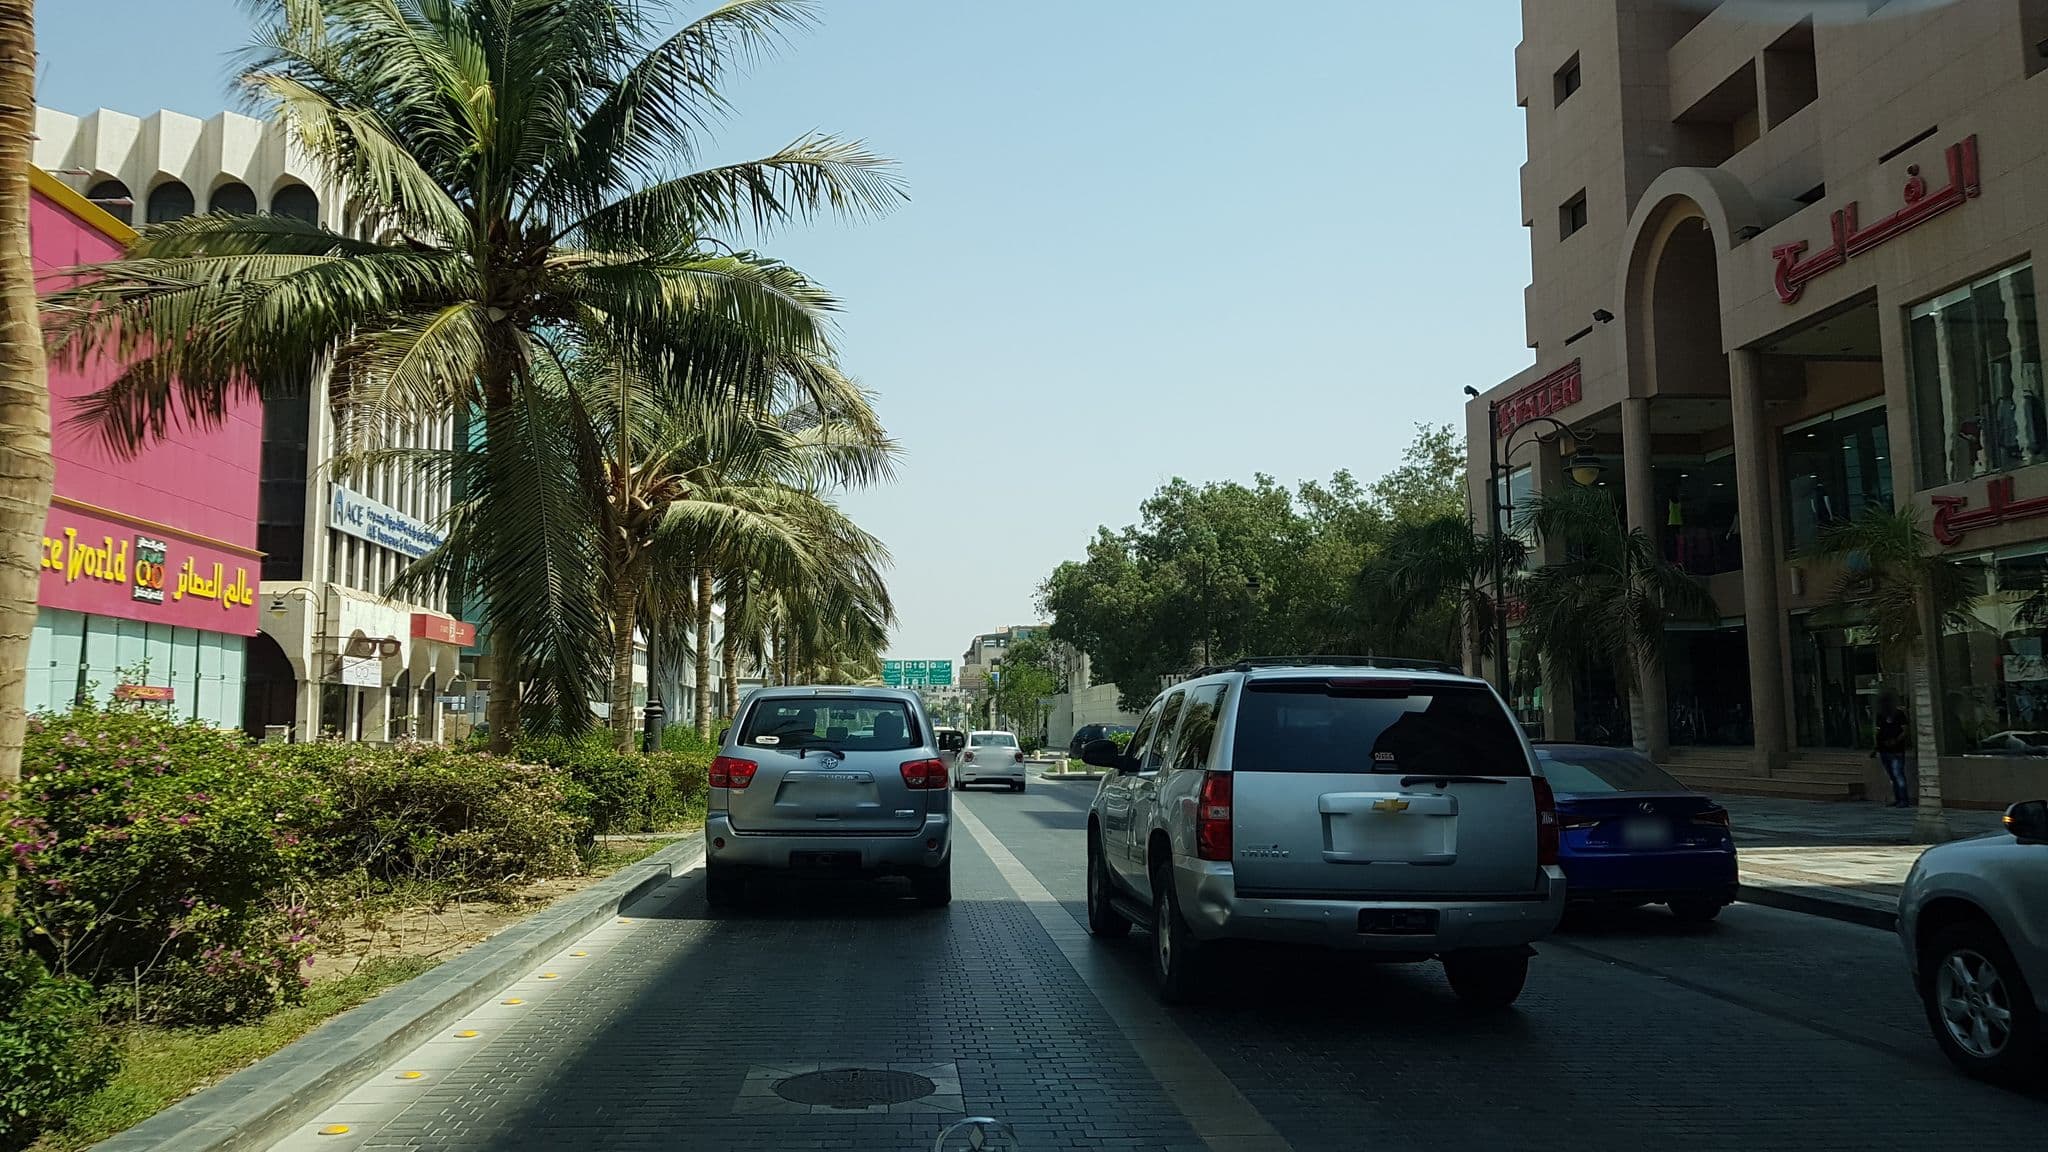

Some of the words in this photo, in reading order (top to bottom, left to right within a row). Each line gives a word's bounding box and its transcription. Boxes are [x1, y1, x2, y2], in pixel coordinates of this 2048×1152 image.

[64, 527, 128, 582] World
[172, 556, 224, 600] العصائر
[223, 567, 254, 608] عالم
